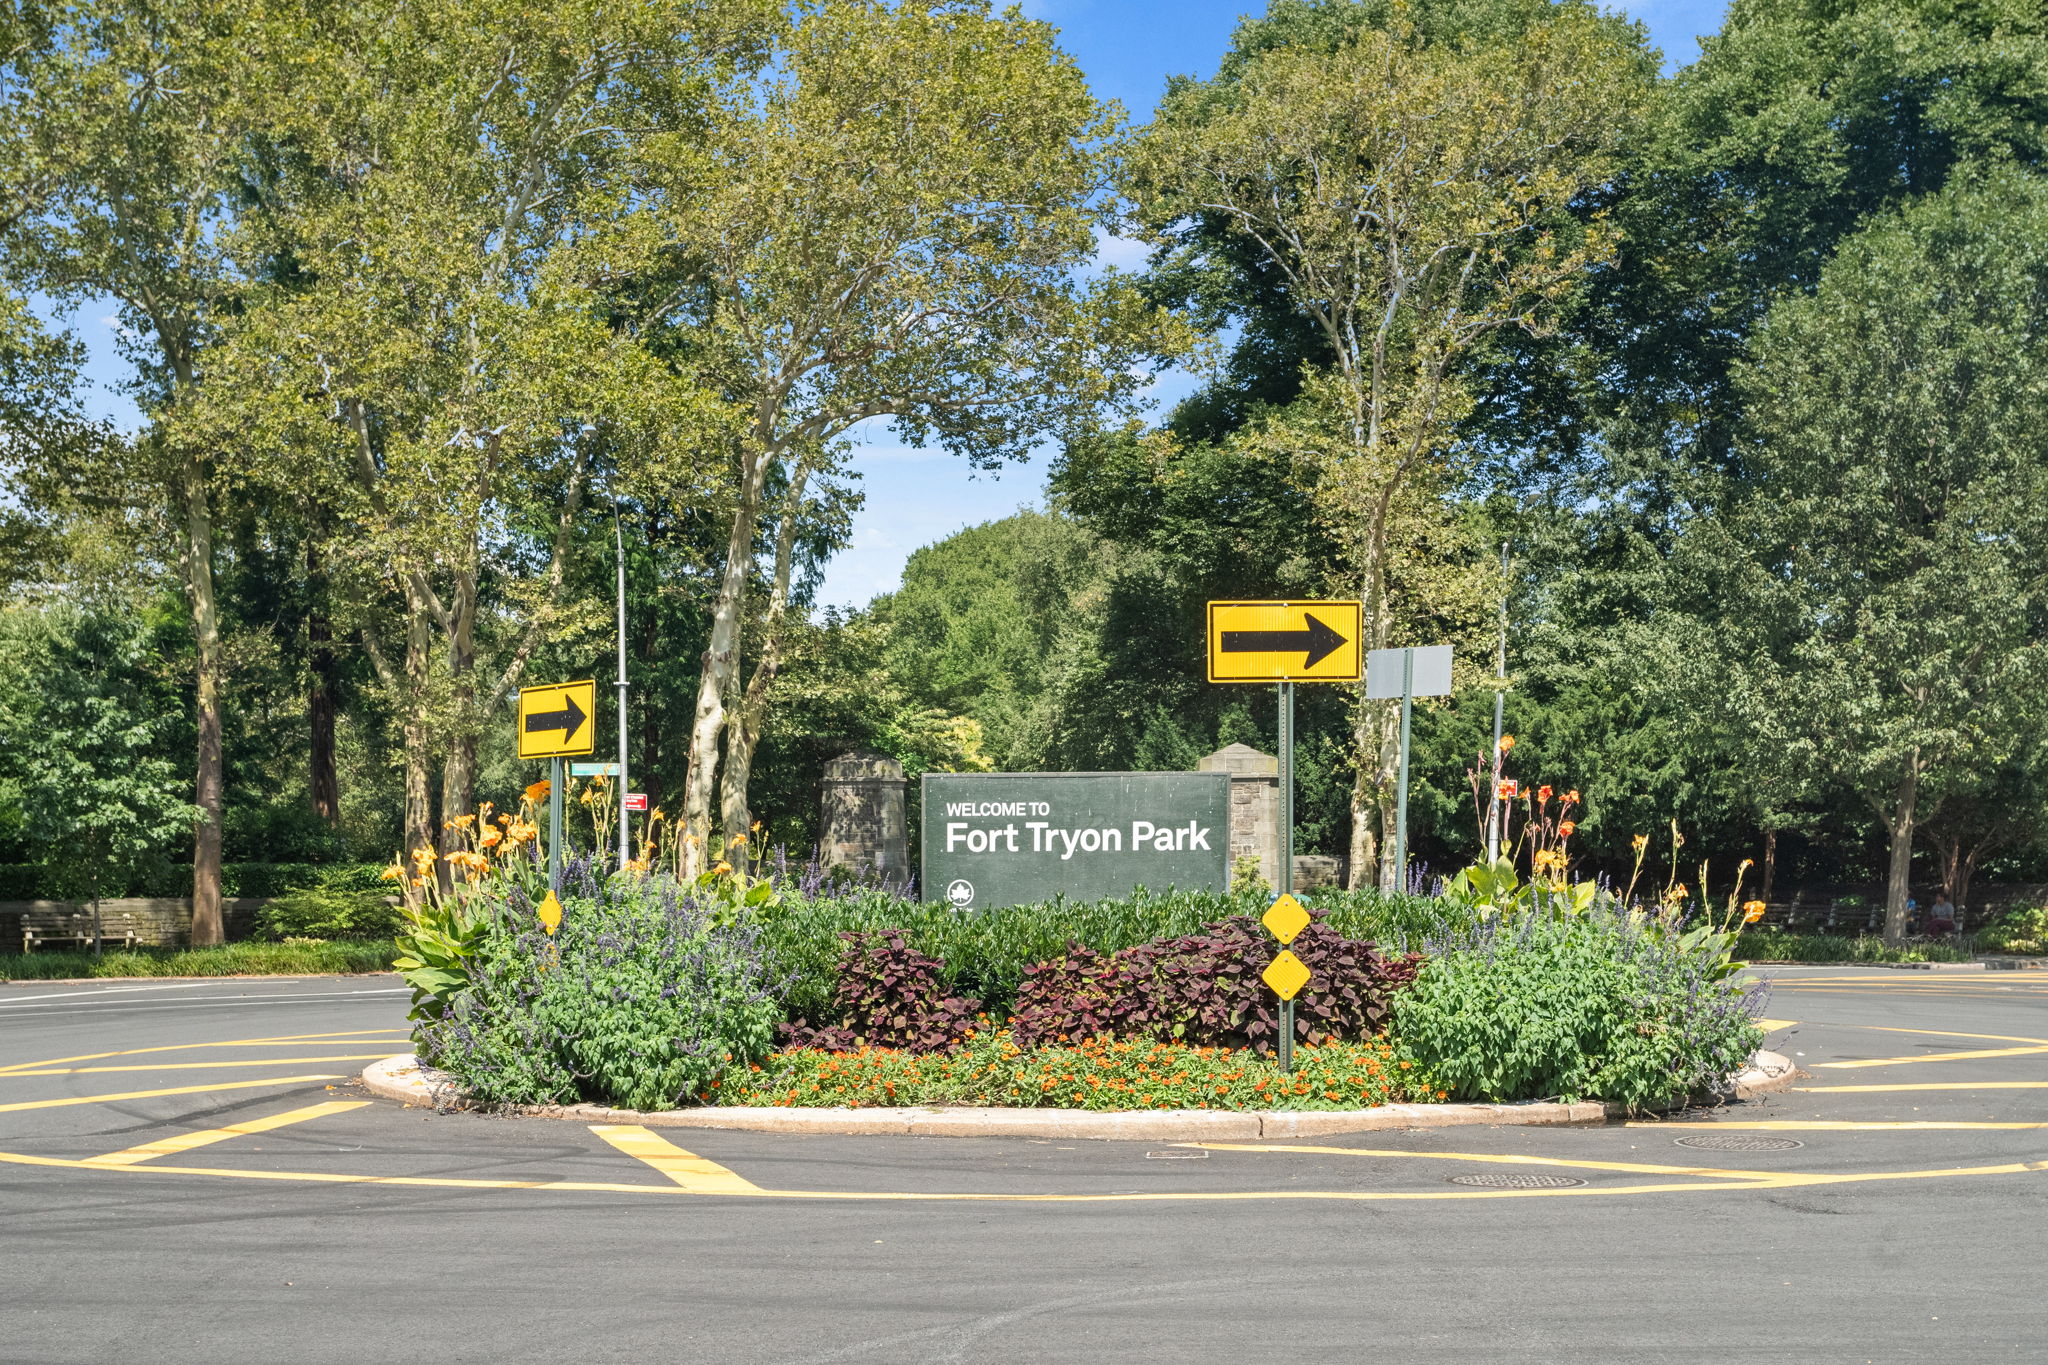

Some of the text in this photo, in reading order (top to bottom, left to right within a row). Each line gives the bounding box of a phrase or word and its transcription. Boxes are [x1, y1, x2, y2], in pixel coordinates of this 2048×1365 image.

[946, 802, 1051, 817] WELCOME TO
[946, 820, 1212, 861] Fort Tryon Park
